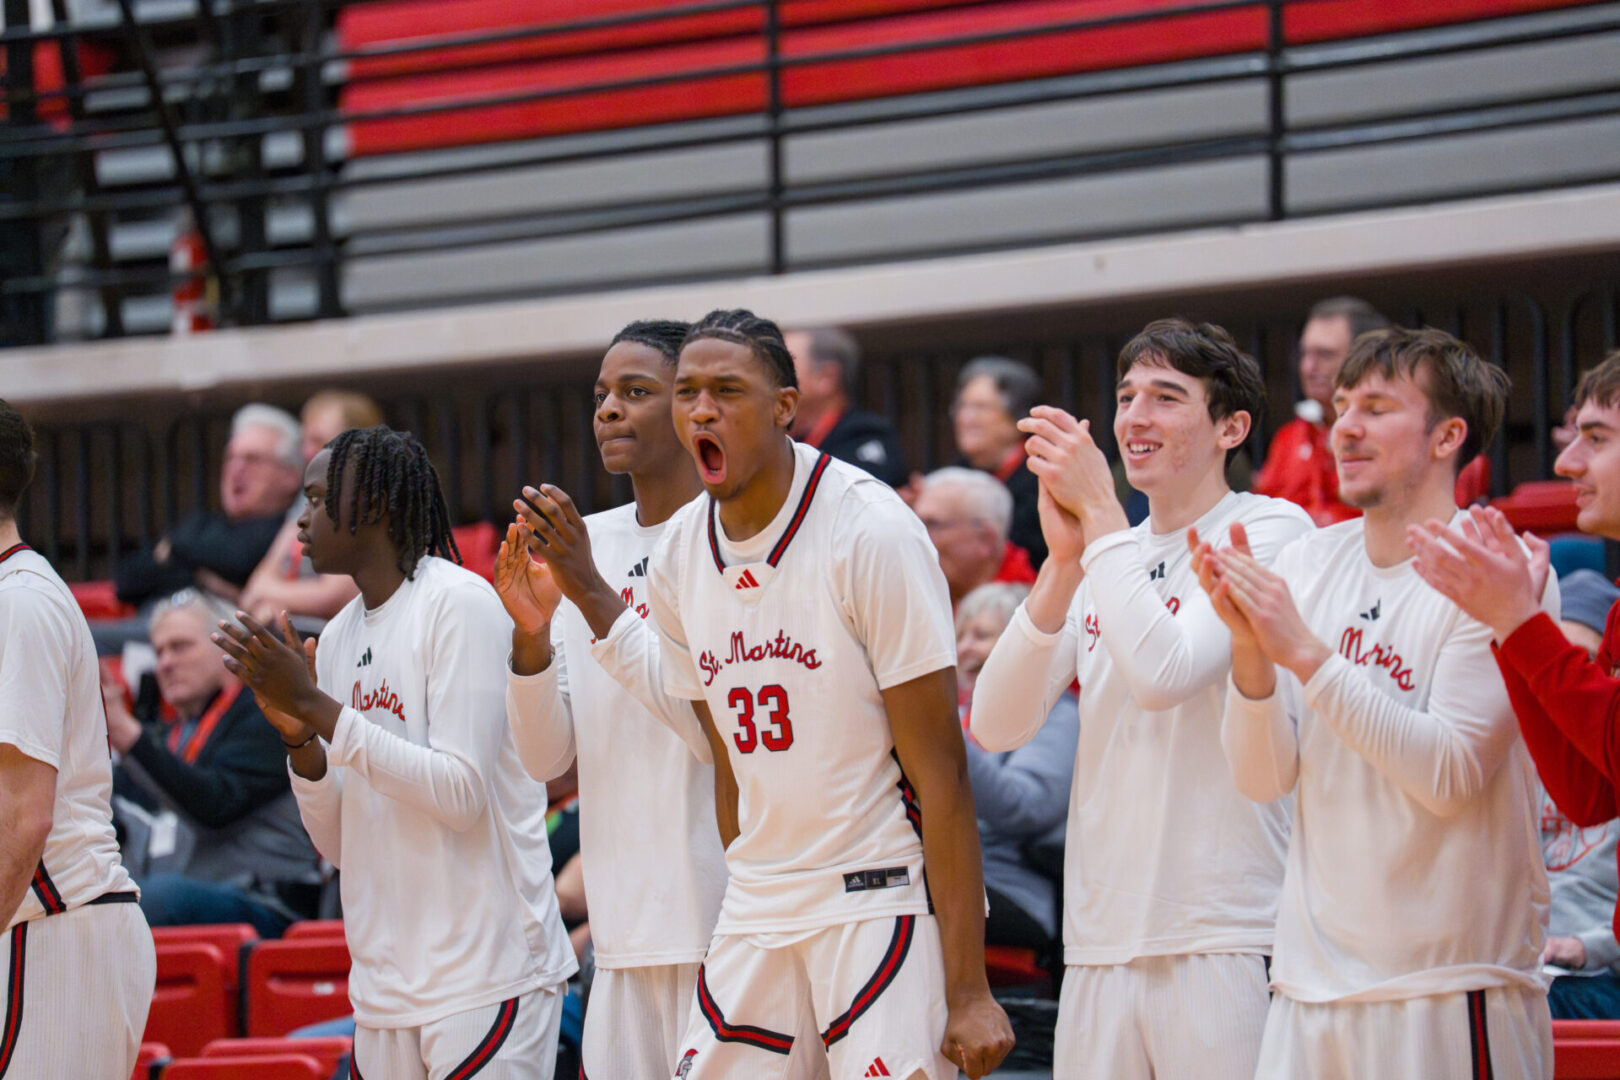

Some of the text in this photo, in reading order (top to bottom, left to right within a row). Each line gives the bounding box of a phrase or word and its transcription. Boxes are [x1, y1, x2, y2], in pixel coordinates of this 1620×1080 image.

[699, 628, 822, 687] St. Martins
[727, 683, 794, 754] 33
